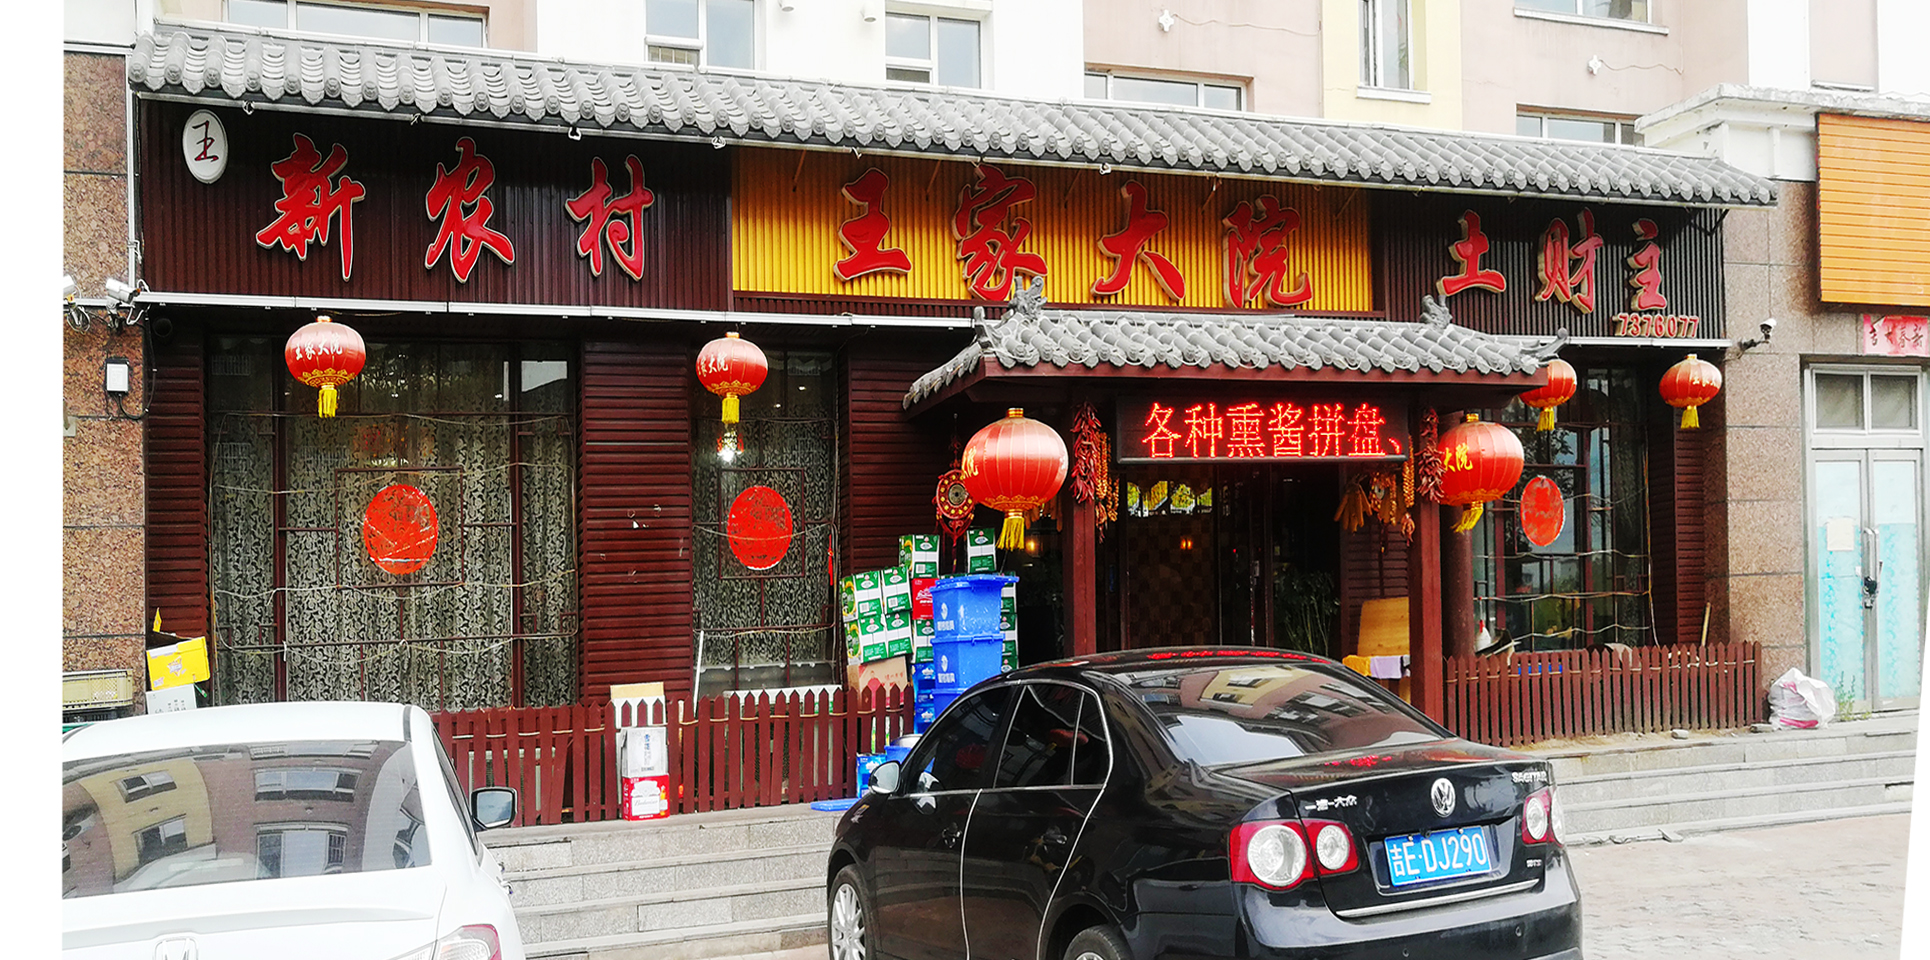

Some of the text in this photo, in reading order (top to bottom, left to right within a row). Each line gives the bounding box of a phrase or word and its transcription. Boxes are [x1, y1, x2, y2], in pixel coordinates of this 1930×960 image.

[193, 121, 221, 163] 王
[256, 132, 655, 283] 新农村
[833, 163, 1312, 309] 王家大院
[1437, 207, 1669, 315] 土财主
[295, 332, 343, 361] 王家大院
[1614, 313, 1700, 339] 7376077
[697, 351, 729, 378] 家大院
